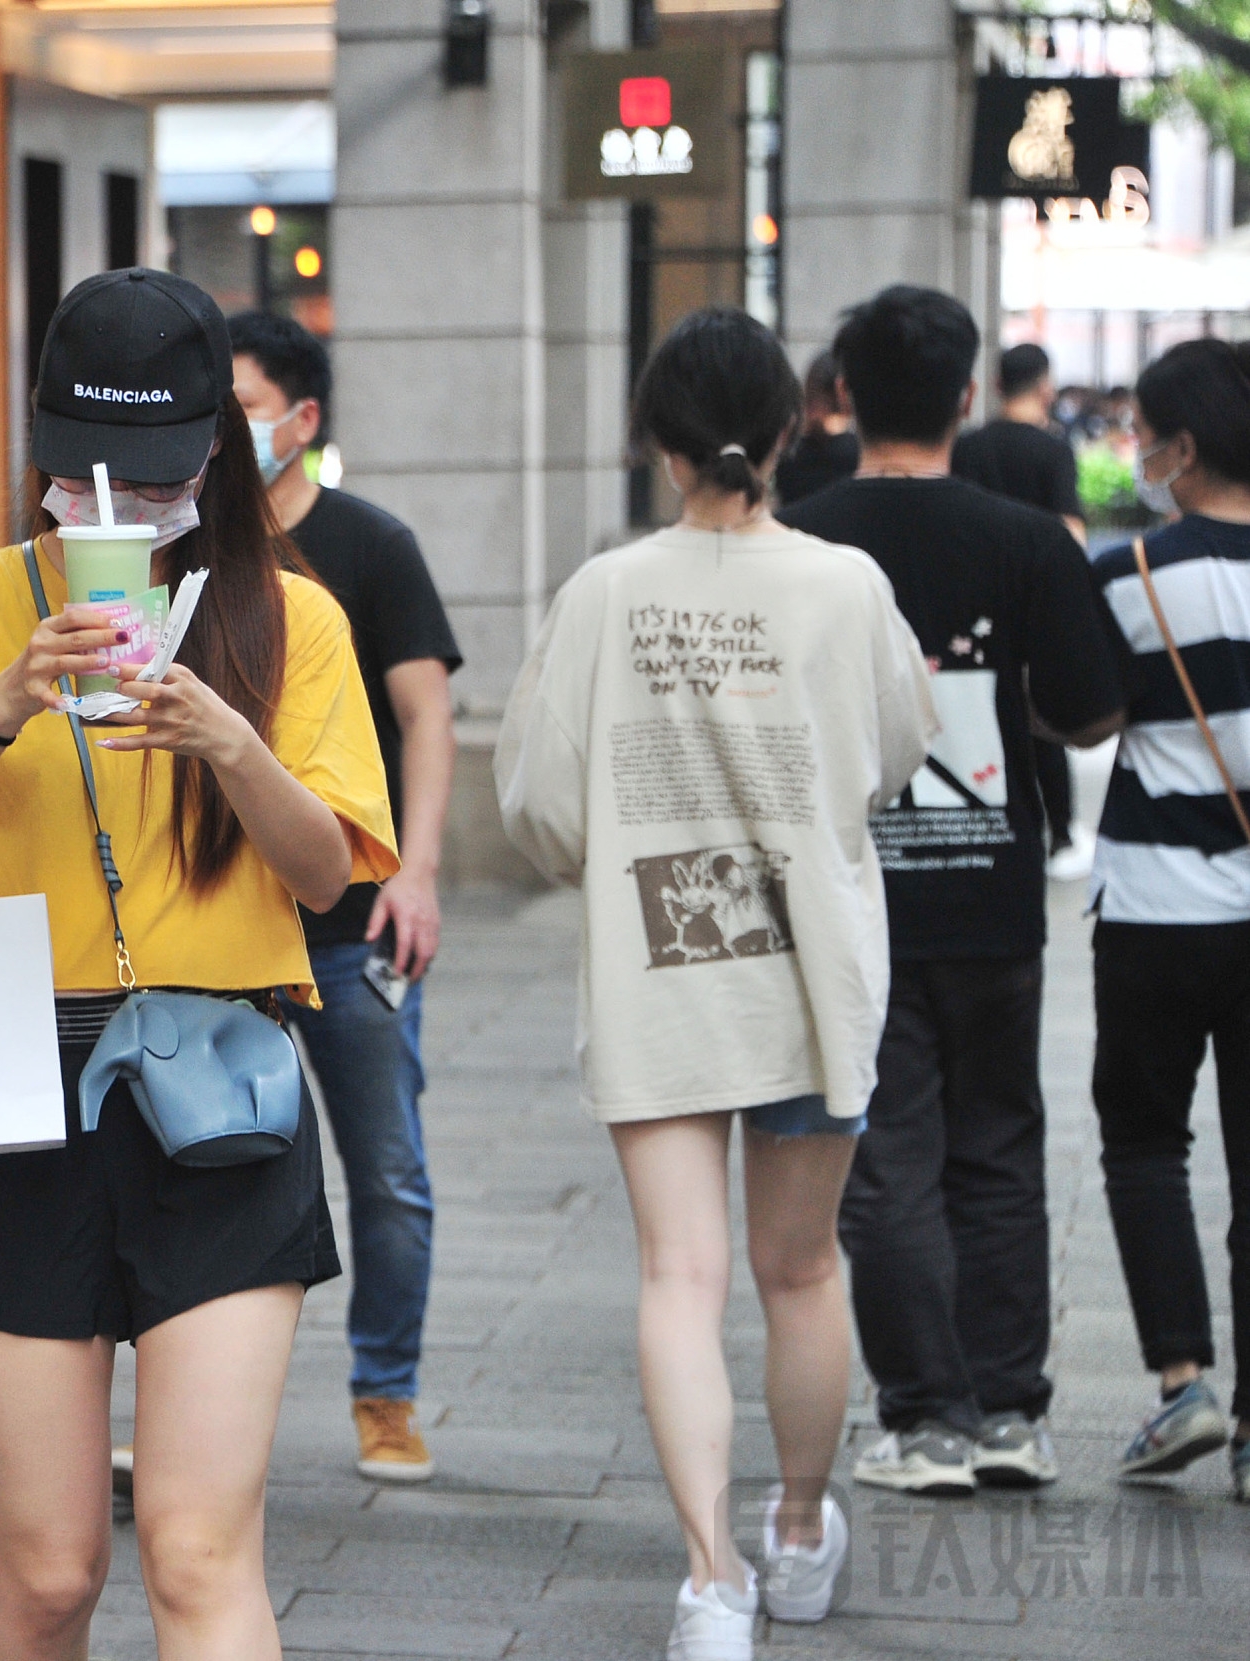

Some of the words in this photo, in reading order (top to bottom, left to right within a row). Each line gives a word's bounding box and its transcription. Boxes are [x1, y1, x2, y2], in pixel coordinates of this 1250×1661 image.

[74, 383, 173, 404] BALENCIAGA
[672, 611, 725, 632] 1976
[733, 612, 767, 635] OK
[666, 634, 701, 650] YOU
[708, 638, 766, 652] STILL
[695, 656, 731, 676] SAY
[650, 681, 676, 696] ON
[687, 679, 720, 699] TV
